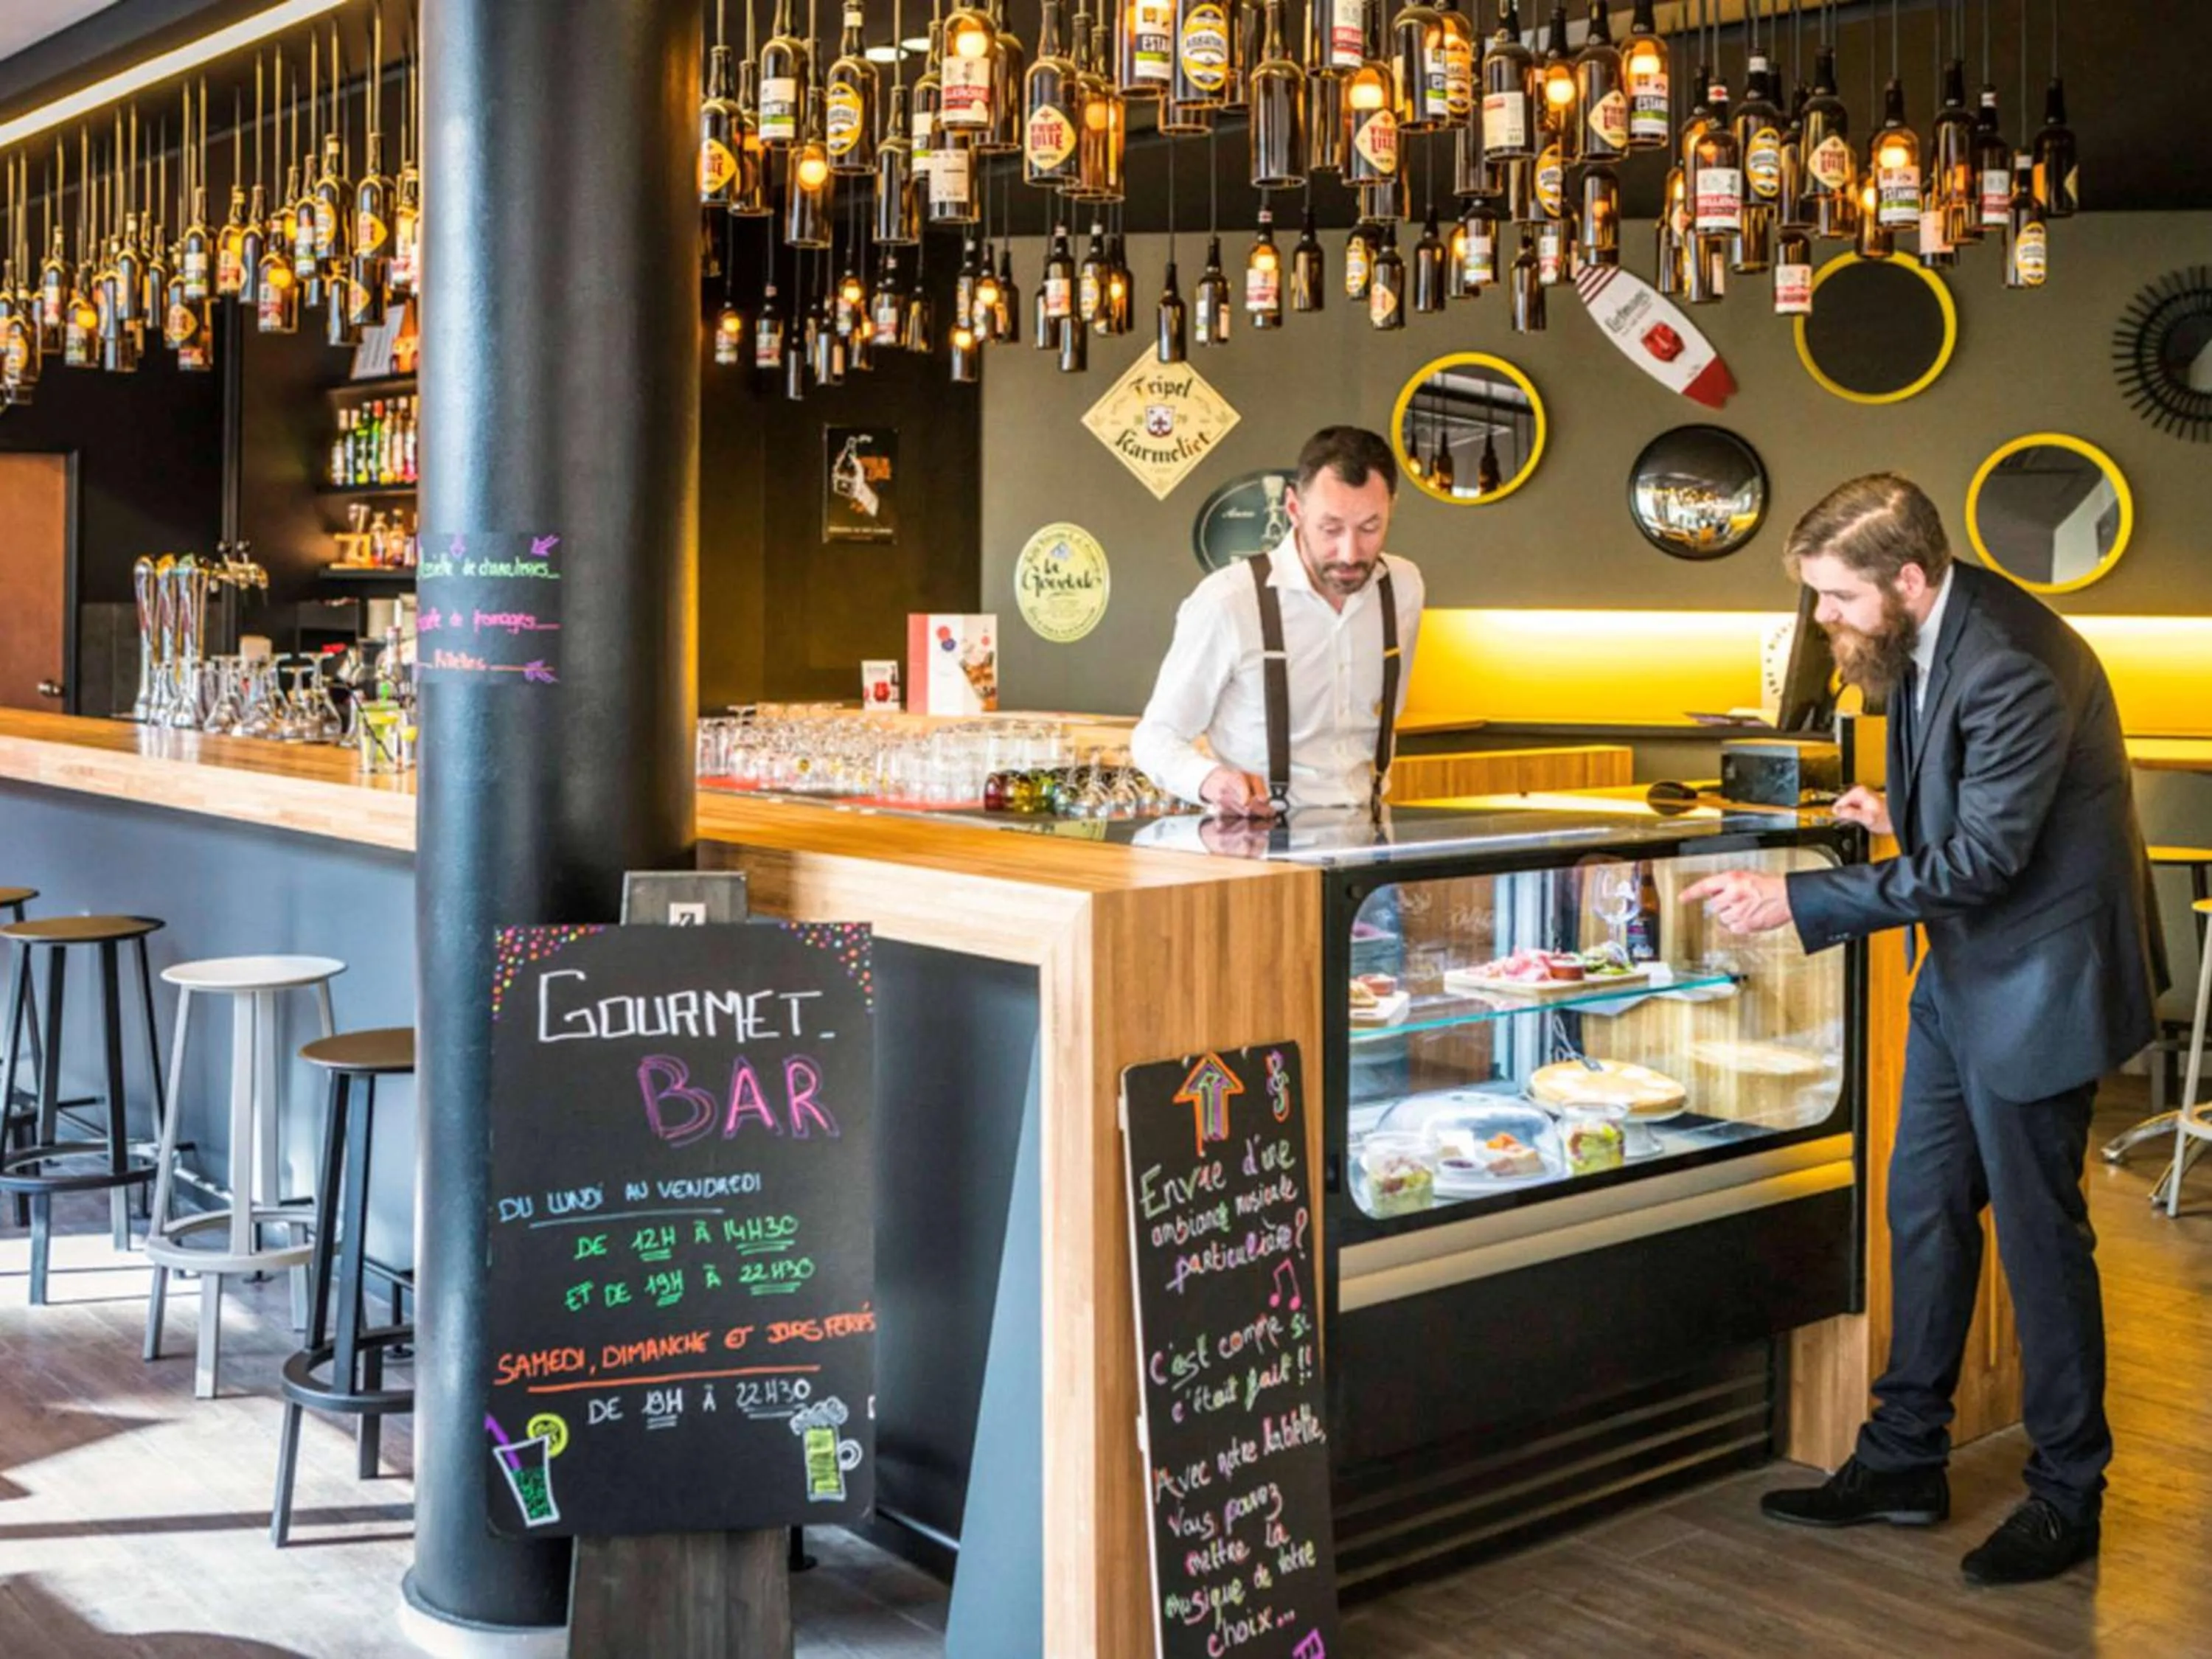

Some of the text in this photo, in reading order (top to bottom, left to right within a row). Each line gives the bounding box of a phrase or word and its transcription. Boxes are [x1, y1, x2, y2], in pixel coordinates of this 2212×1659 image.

[1130, 375, 1193, 399] Tripel
[1116, 428, 1211, 464] Karmeliet
[538, 969, 823, 1043] GOURMET
[637, 1053, 840, 1147] BAR
[498, 1196, 535, 1222] DU
[625, 1180, 650, 1202] AU
[657, 1172, 762, 1199] VENDREDI
[1140, 1151, 1227, 1220] Envie
[574, 1234, 608, 1260] DE
[630, 1225, 677, 1251] 12H
[723, 1214, 799, 1243] 14H30
[564, 1280, 594, 1312] ET
[603, 1281, 633, 1307] DE
[644, 1268, 685, 1296] 19H
[739, 1256, 815, 1284] 22H30
[602, 1329, 712, 1369] DIMANCHE
[588, 1396, 624, 1426] DE
[735, 1377, 812, 1408] 22H30
[1153, 1459, 1212, 1504] Avec
[1253, 1562, 1274, 1589] de
